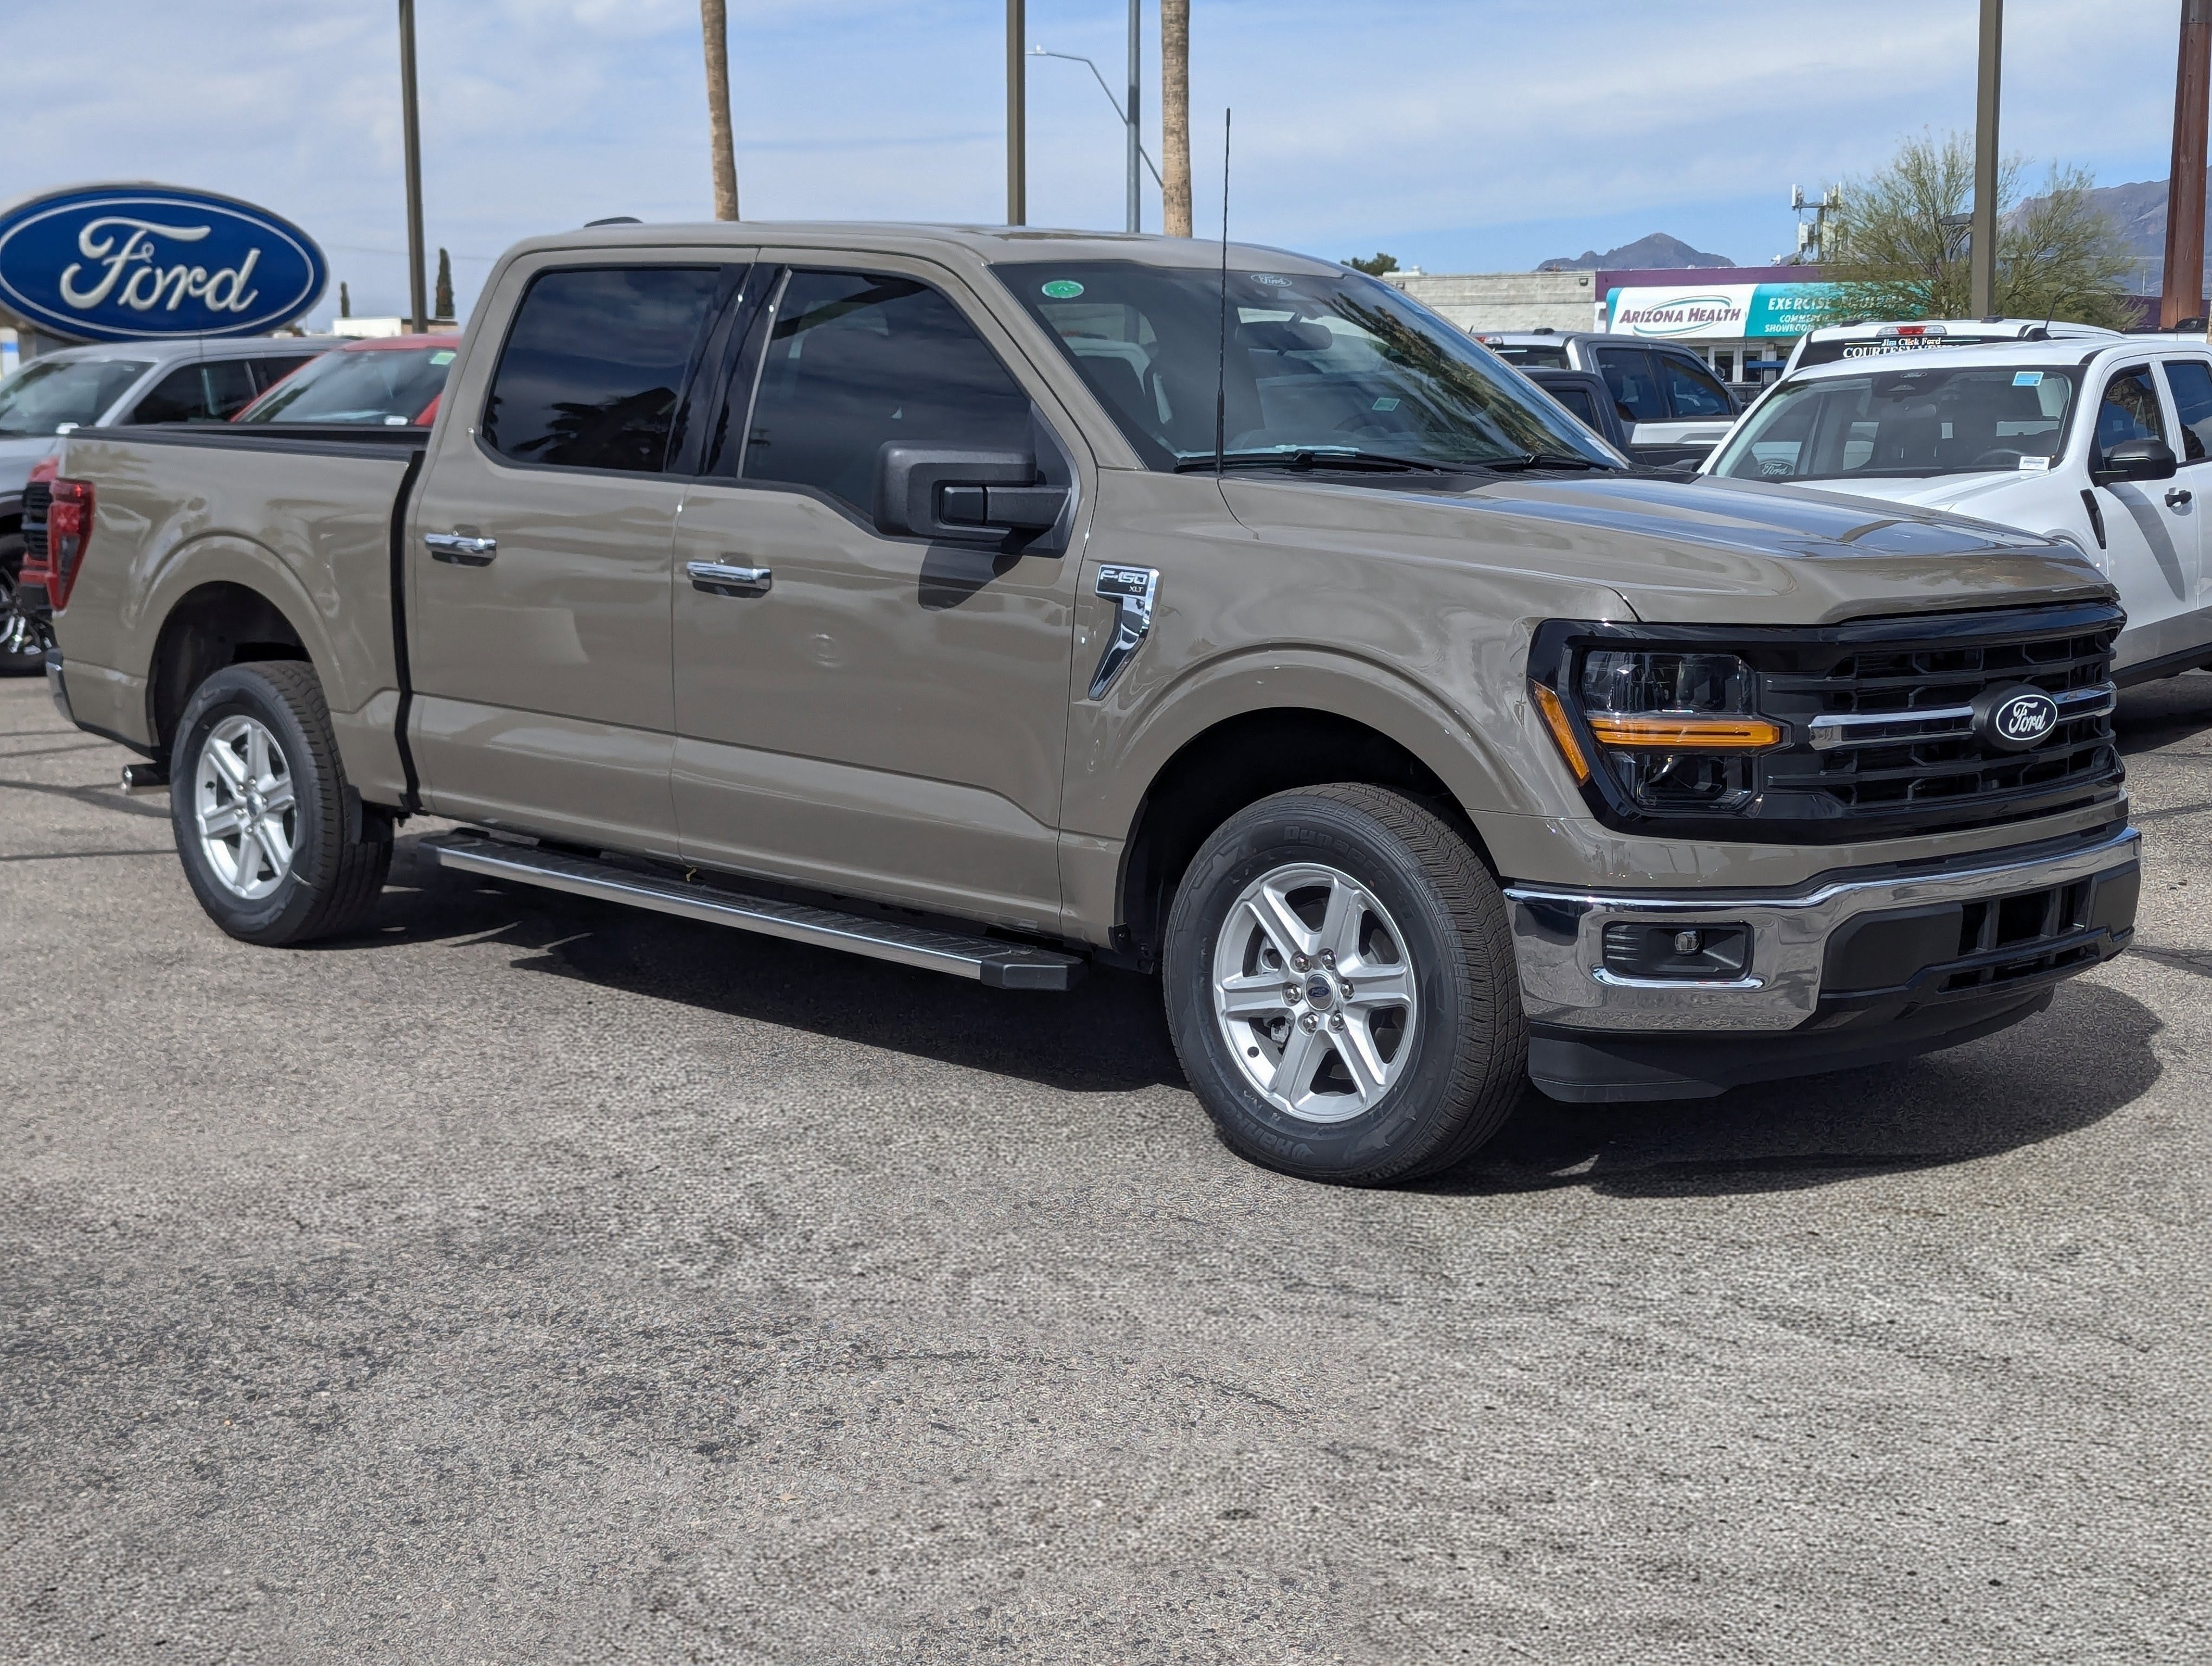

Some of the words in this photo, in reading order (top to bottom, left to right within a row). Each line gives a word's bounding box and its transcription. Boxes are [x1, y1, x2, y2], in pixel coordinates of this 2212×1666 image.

[60, 216, 261, 312] Ford
[1619, 307, 1684, 324] ARIZONA
[1687, 306, 1741, 322] HEALTH
[1898, 338, 1920, 346] Click
[1922, 337, 1941, 345] Ford
[1100, 569, 1148, 585] F-150
[2008, 701, 2047, 734] Ford
